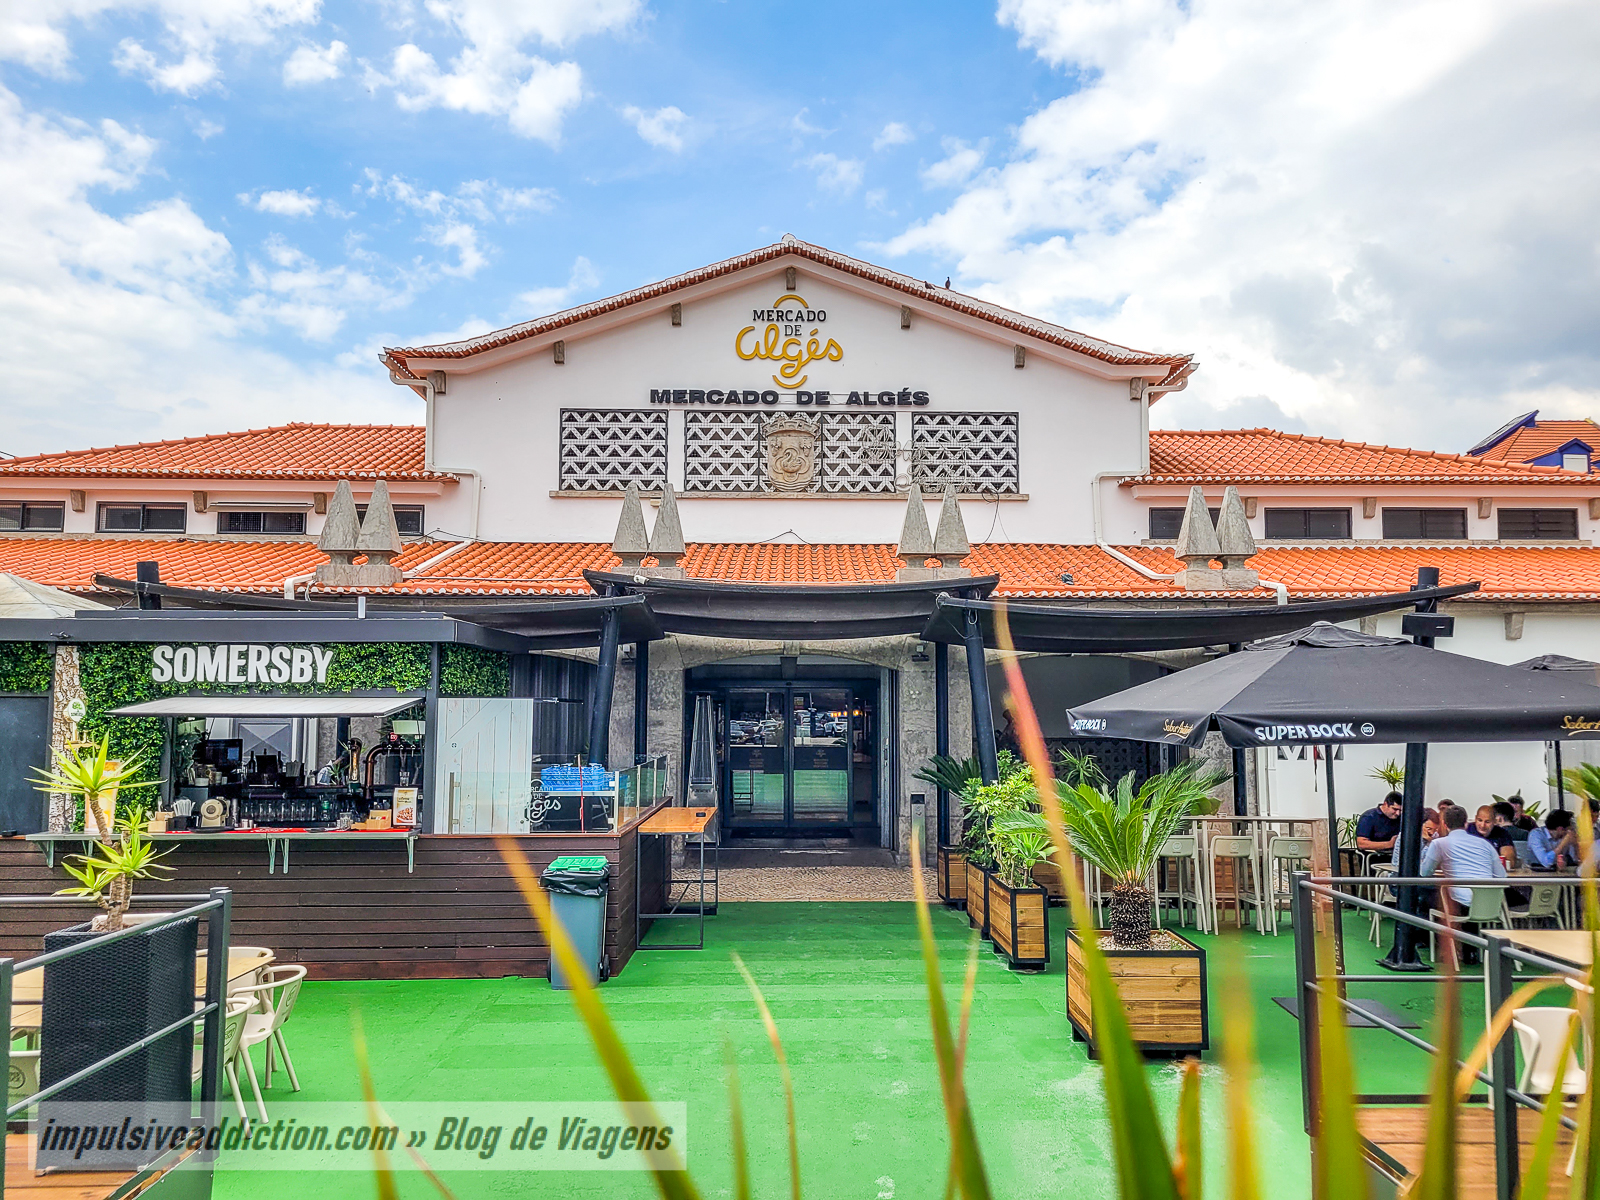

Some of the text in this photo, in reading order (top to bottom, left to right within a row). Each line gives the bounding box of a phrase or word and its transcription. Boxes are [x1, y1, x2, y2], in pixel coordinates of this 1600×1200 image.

[752, 309, 827, 322] MERCADO
[784, 324, 802, 337] DE
[650, 387, 931, 406] MERCADO DE ALGÉS
[151, 644, 334, 684] SOMERSBY
[1254, 725, 1309, 740] SUPER
[1307, 722, 1357, 738] BOCK
